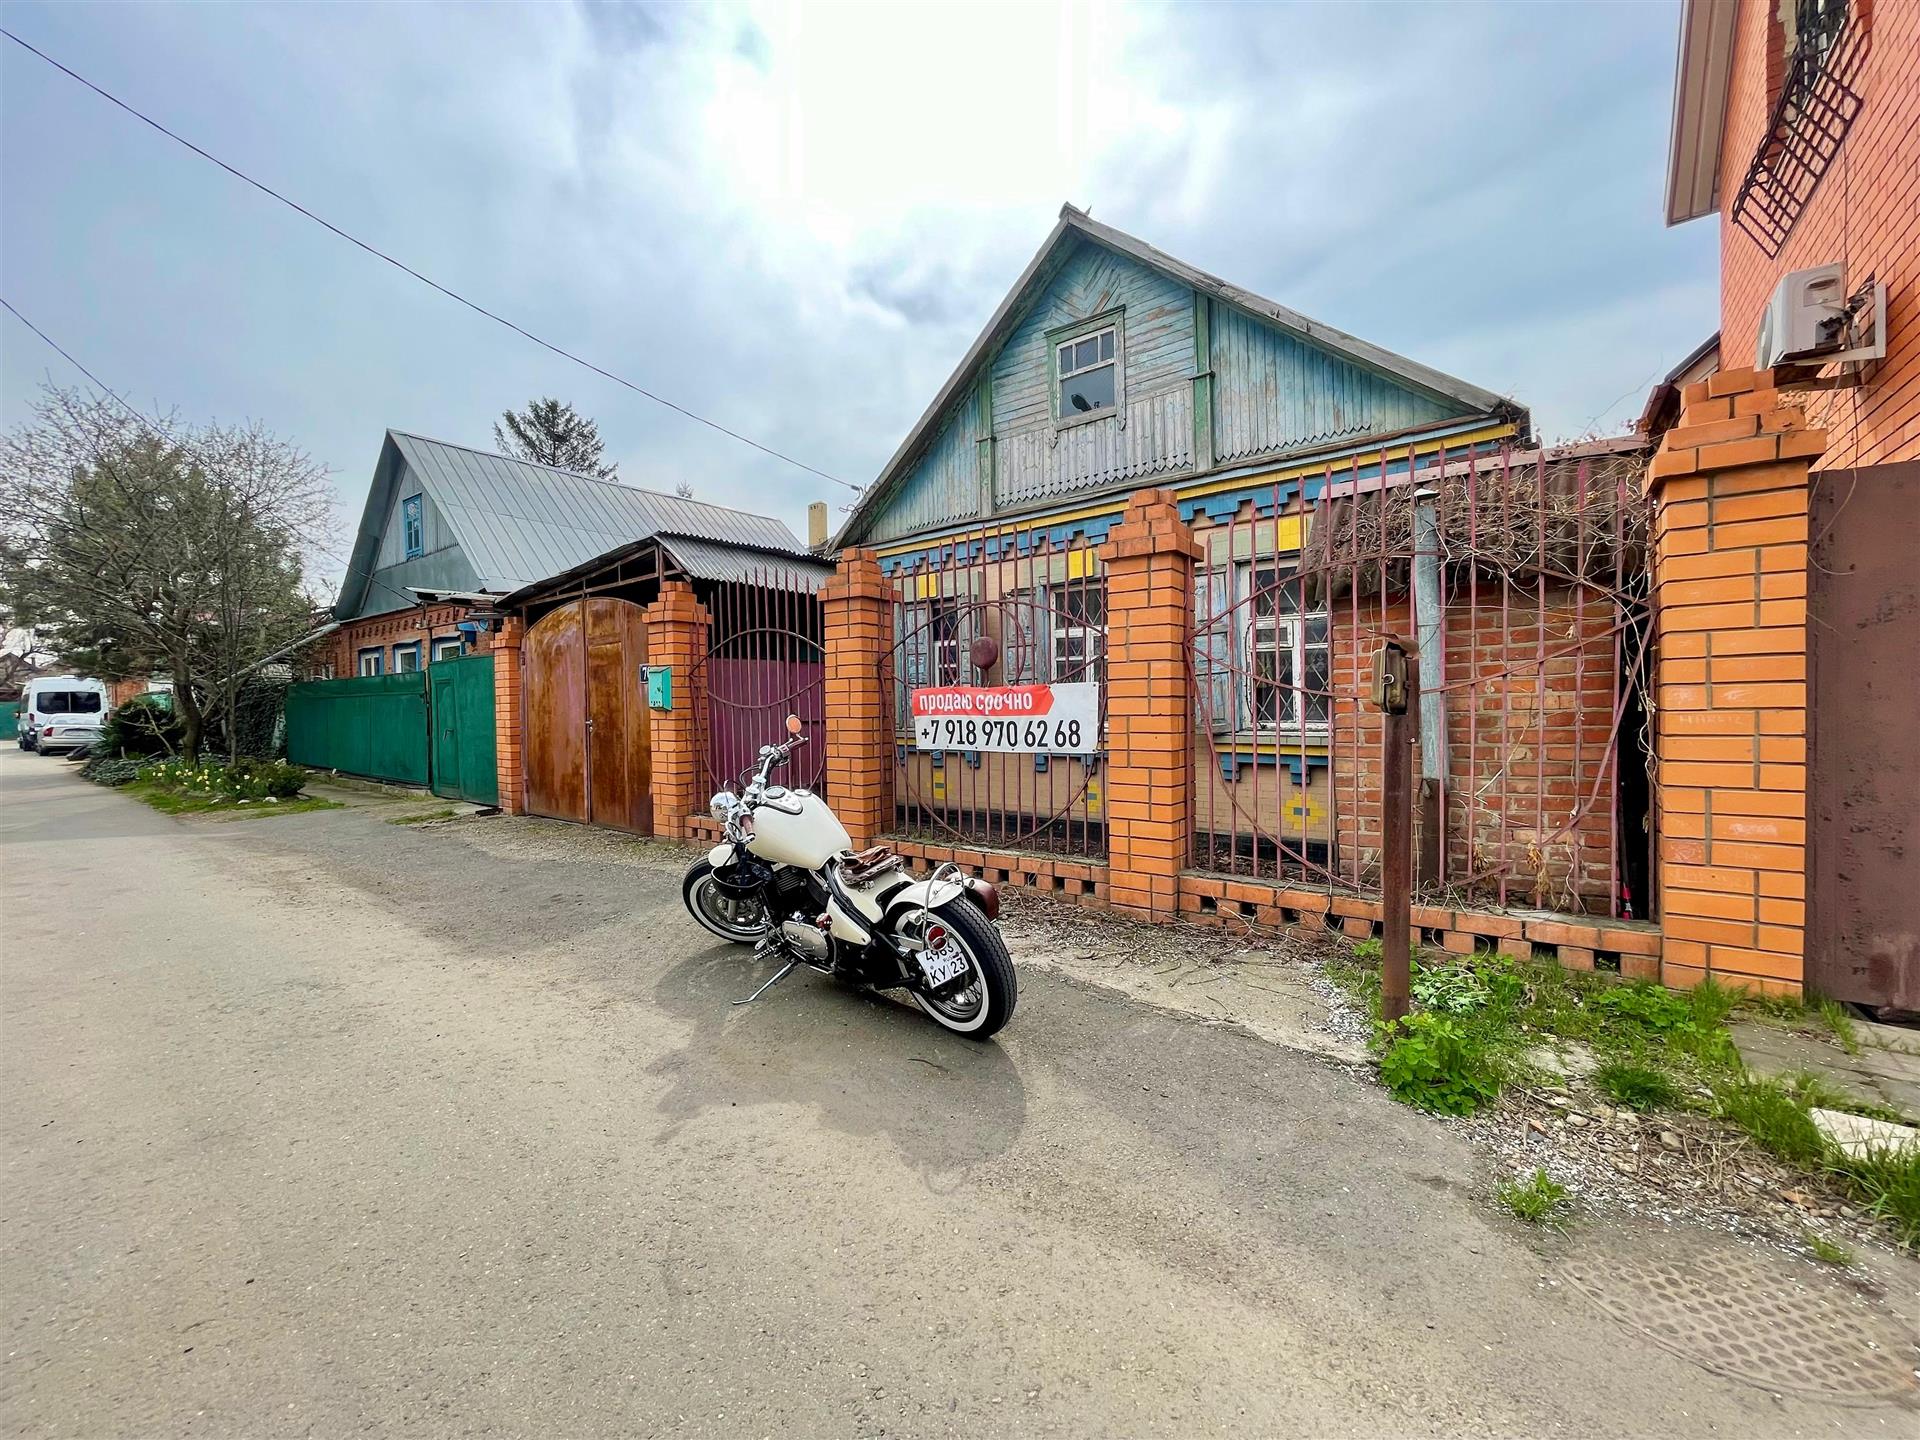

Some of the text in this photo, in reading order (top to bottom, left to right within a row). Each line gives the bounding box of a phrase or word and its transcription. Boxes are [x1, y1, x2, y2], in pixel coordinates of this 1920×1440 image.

[919, 692, 1033, 715] продаю срочно
[921, 719, 1081, 748] +7 918 970 62 68
[950, 957, 966, 975] 23
